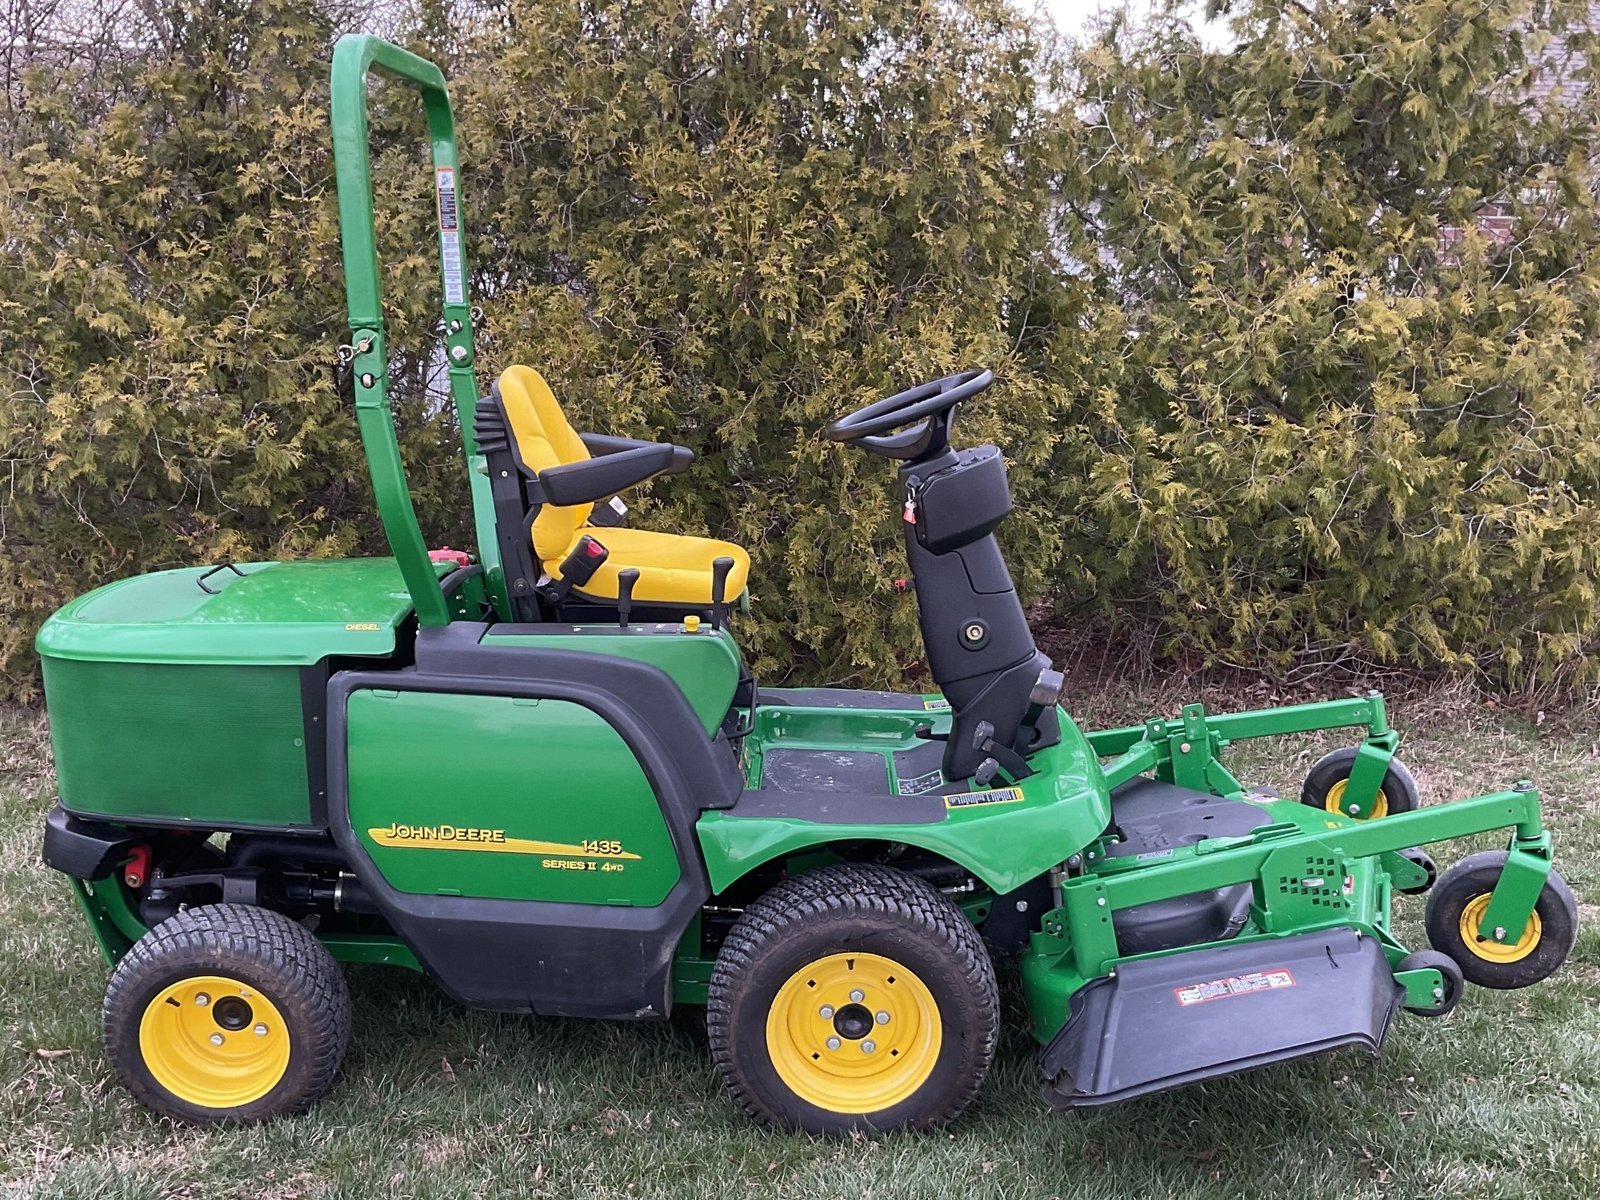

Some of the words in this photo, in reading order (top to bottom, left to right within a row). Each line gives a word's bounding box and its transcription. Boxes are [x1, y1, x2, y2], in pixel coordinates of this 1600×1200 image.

[345, 623, 381, 631] DIESEL
[386, 822, 439, 840] JOHN
[440, 825, 505, 842] DEERE
[582, 839, 622, 854] 1435
[542, 859, 585, 870] SERIES
[587, 861, 597, 871] II
[601, 862, 624, 872] 4WD
